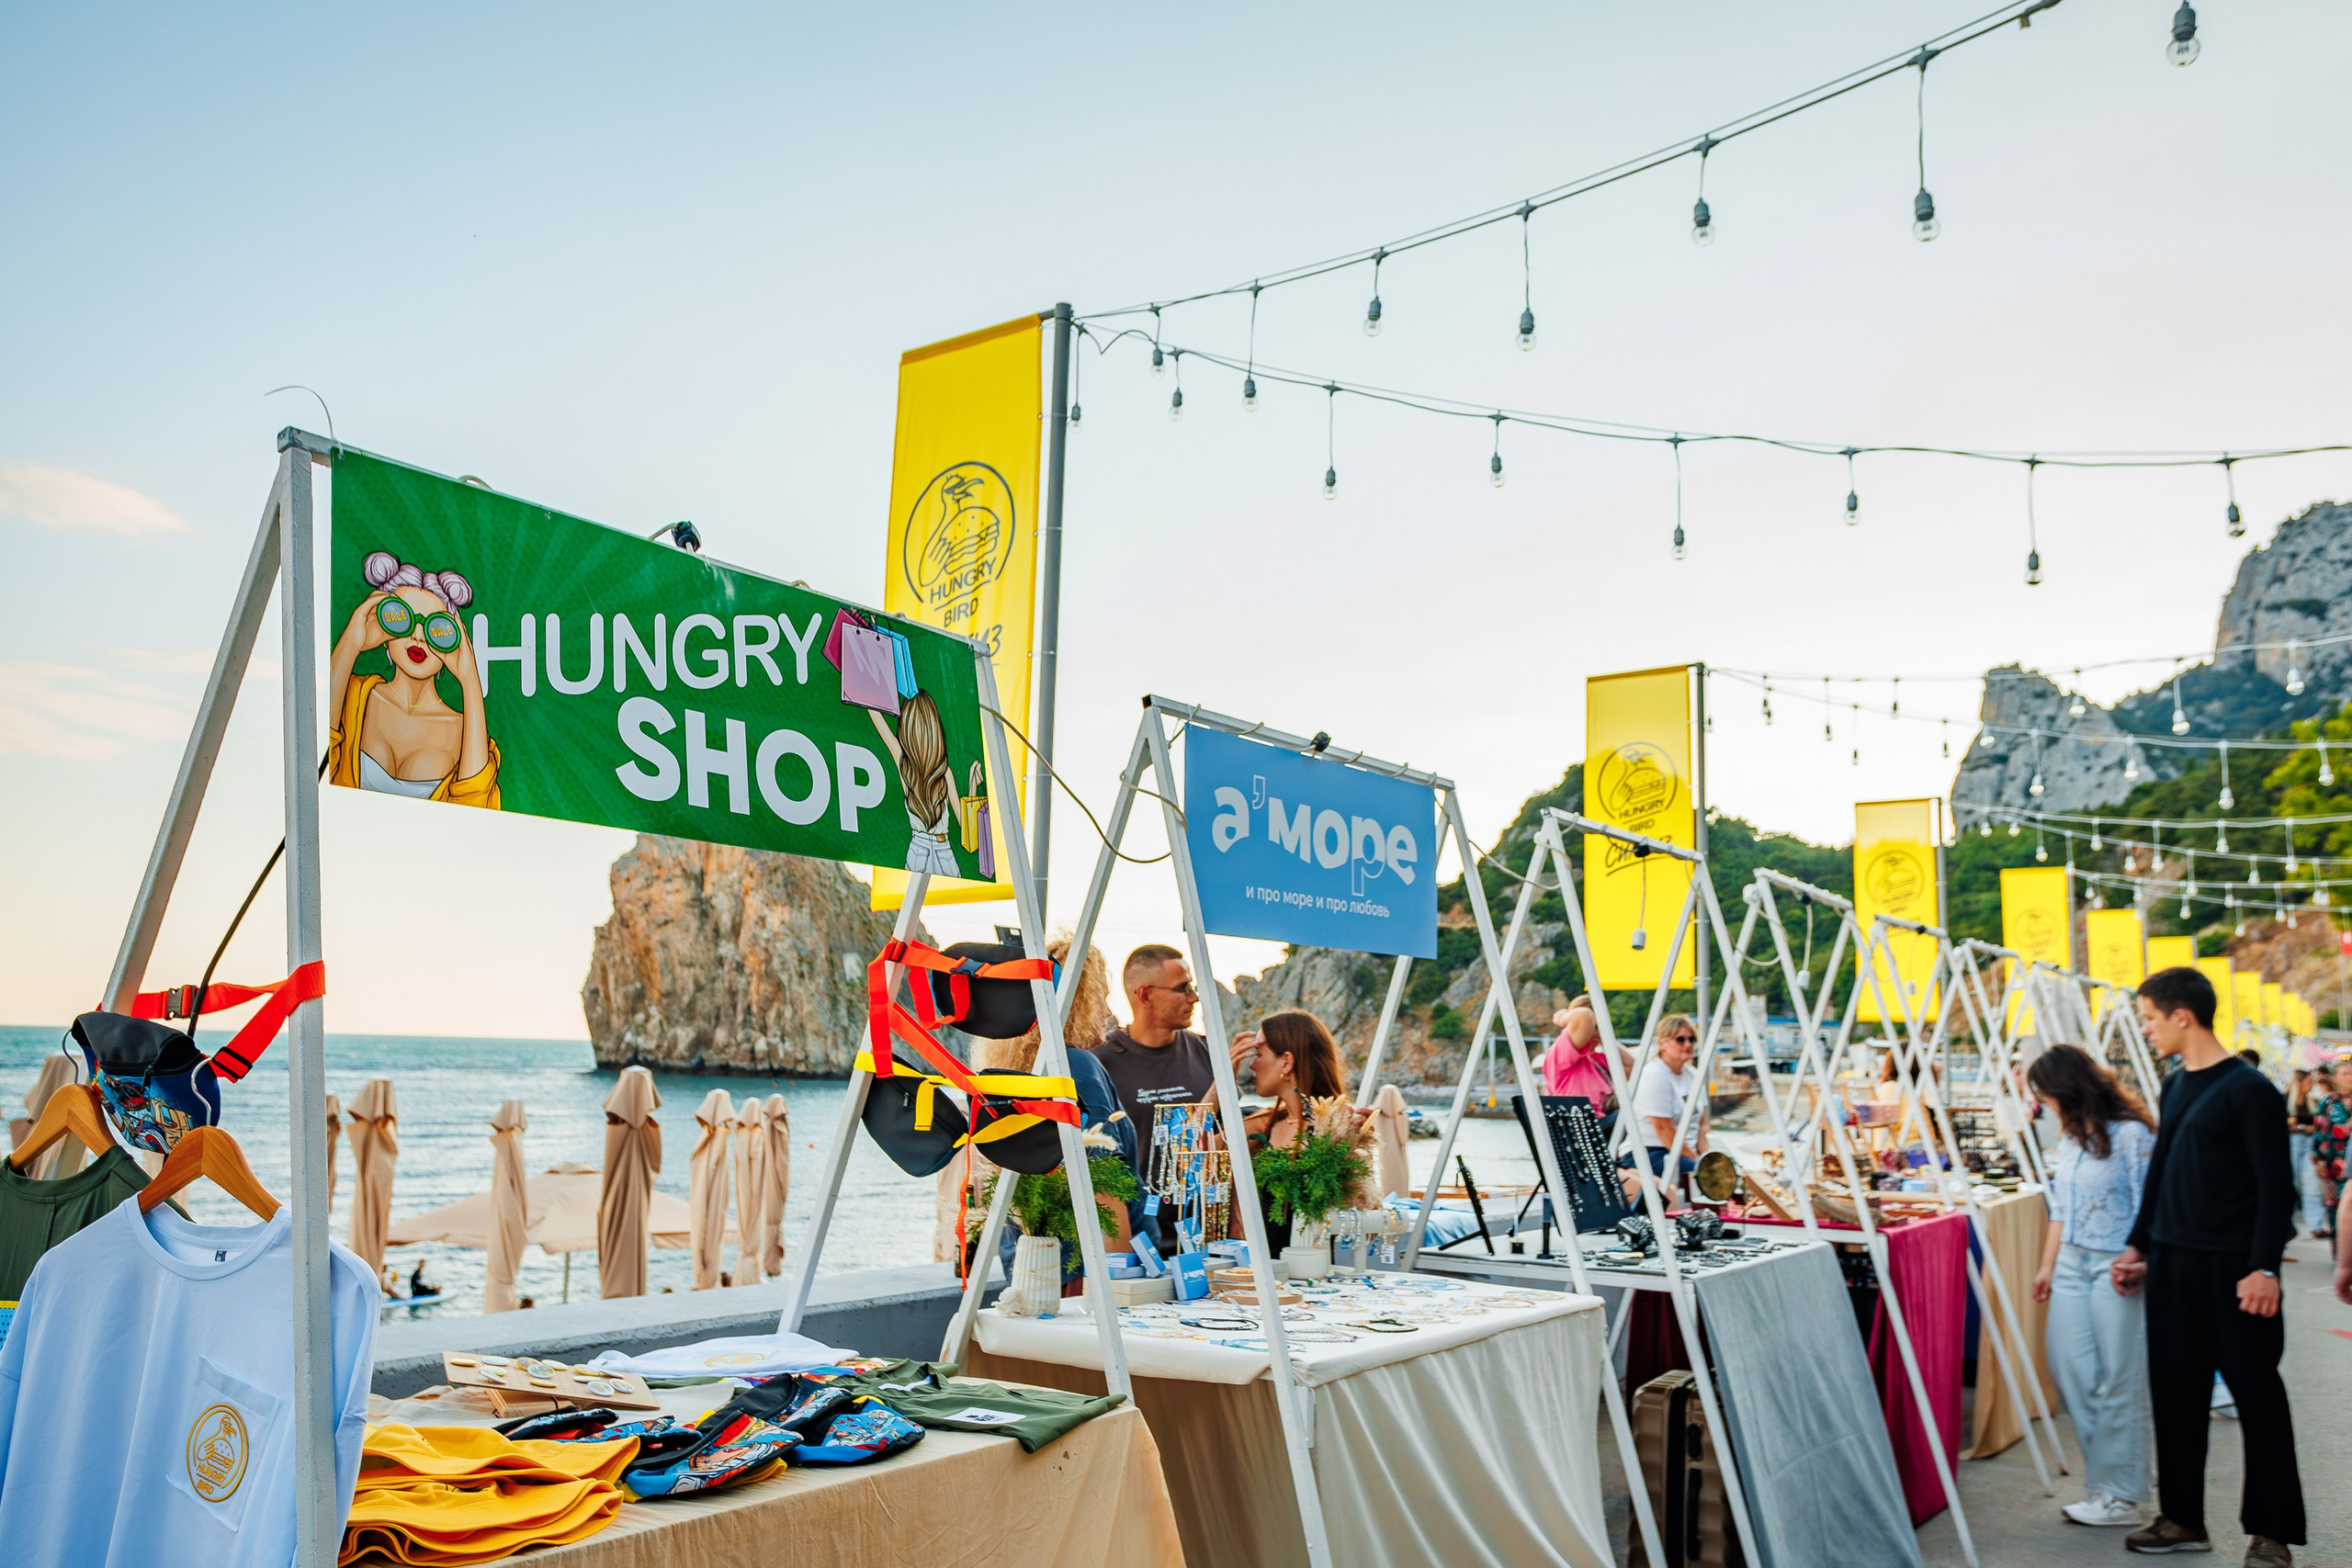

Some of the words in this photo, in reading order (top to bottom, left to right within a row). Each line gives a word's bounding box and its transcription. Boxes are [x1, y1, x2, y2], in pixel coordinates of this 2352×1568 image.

[930, 557, 997, 604] HUNGRY
[383, 608, 408, 623] SALE
[944, 597, 978, 627] BIRD
[430, 625, 454, 637] SALE
[472, 612, 822, 698] HUNGRY
[615, 696, 887, 833] SHOP
[1246, 886, 1254, 899] и
[1257, 886, 1281, 905] про
[1283, 891, 1314, 909] море
[1316, 896, 1324, 908] и
[1326, 897, 1348, 914] про
[1350, 899, 1390, 918] любовь
